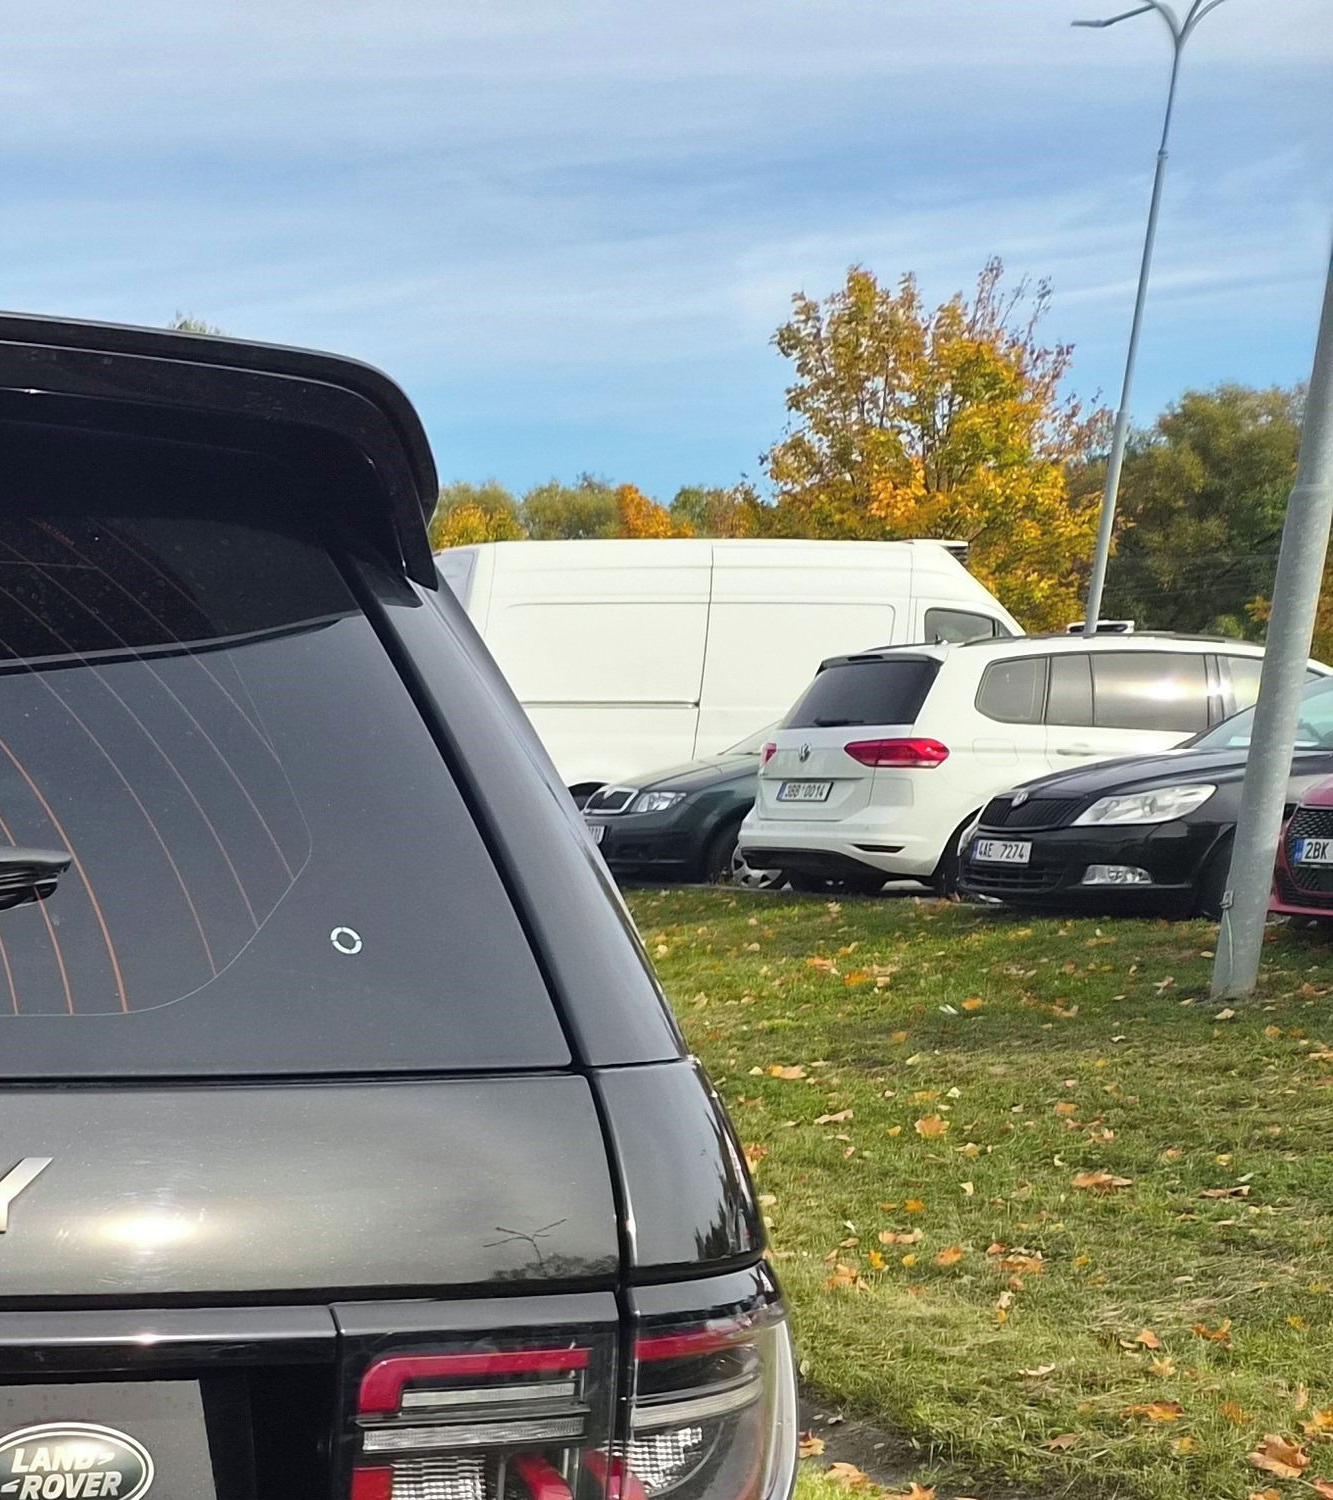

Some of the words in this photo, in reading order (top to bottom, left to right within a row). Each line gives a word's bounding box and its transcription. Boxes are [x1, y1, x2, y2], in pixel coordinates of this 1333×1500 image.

[978, 842, 994, 858] 4AE
[999, 843, 1025, 859] 7274
[1304, 841, 1330, 860] 2BK
[11, 1447, 97, 1473] LAND
[19, 1471, 122, 1500] ROVER
